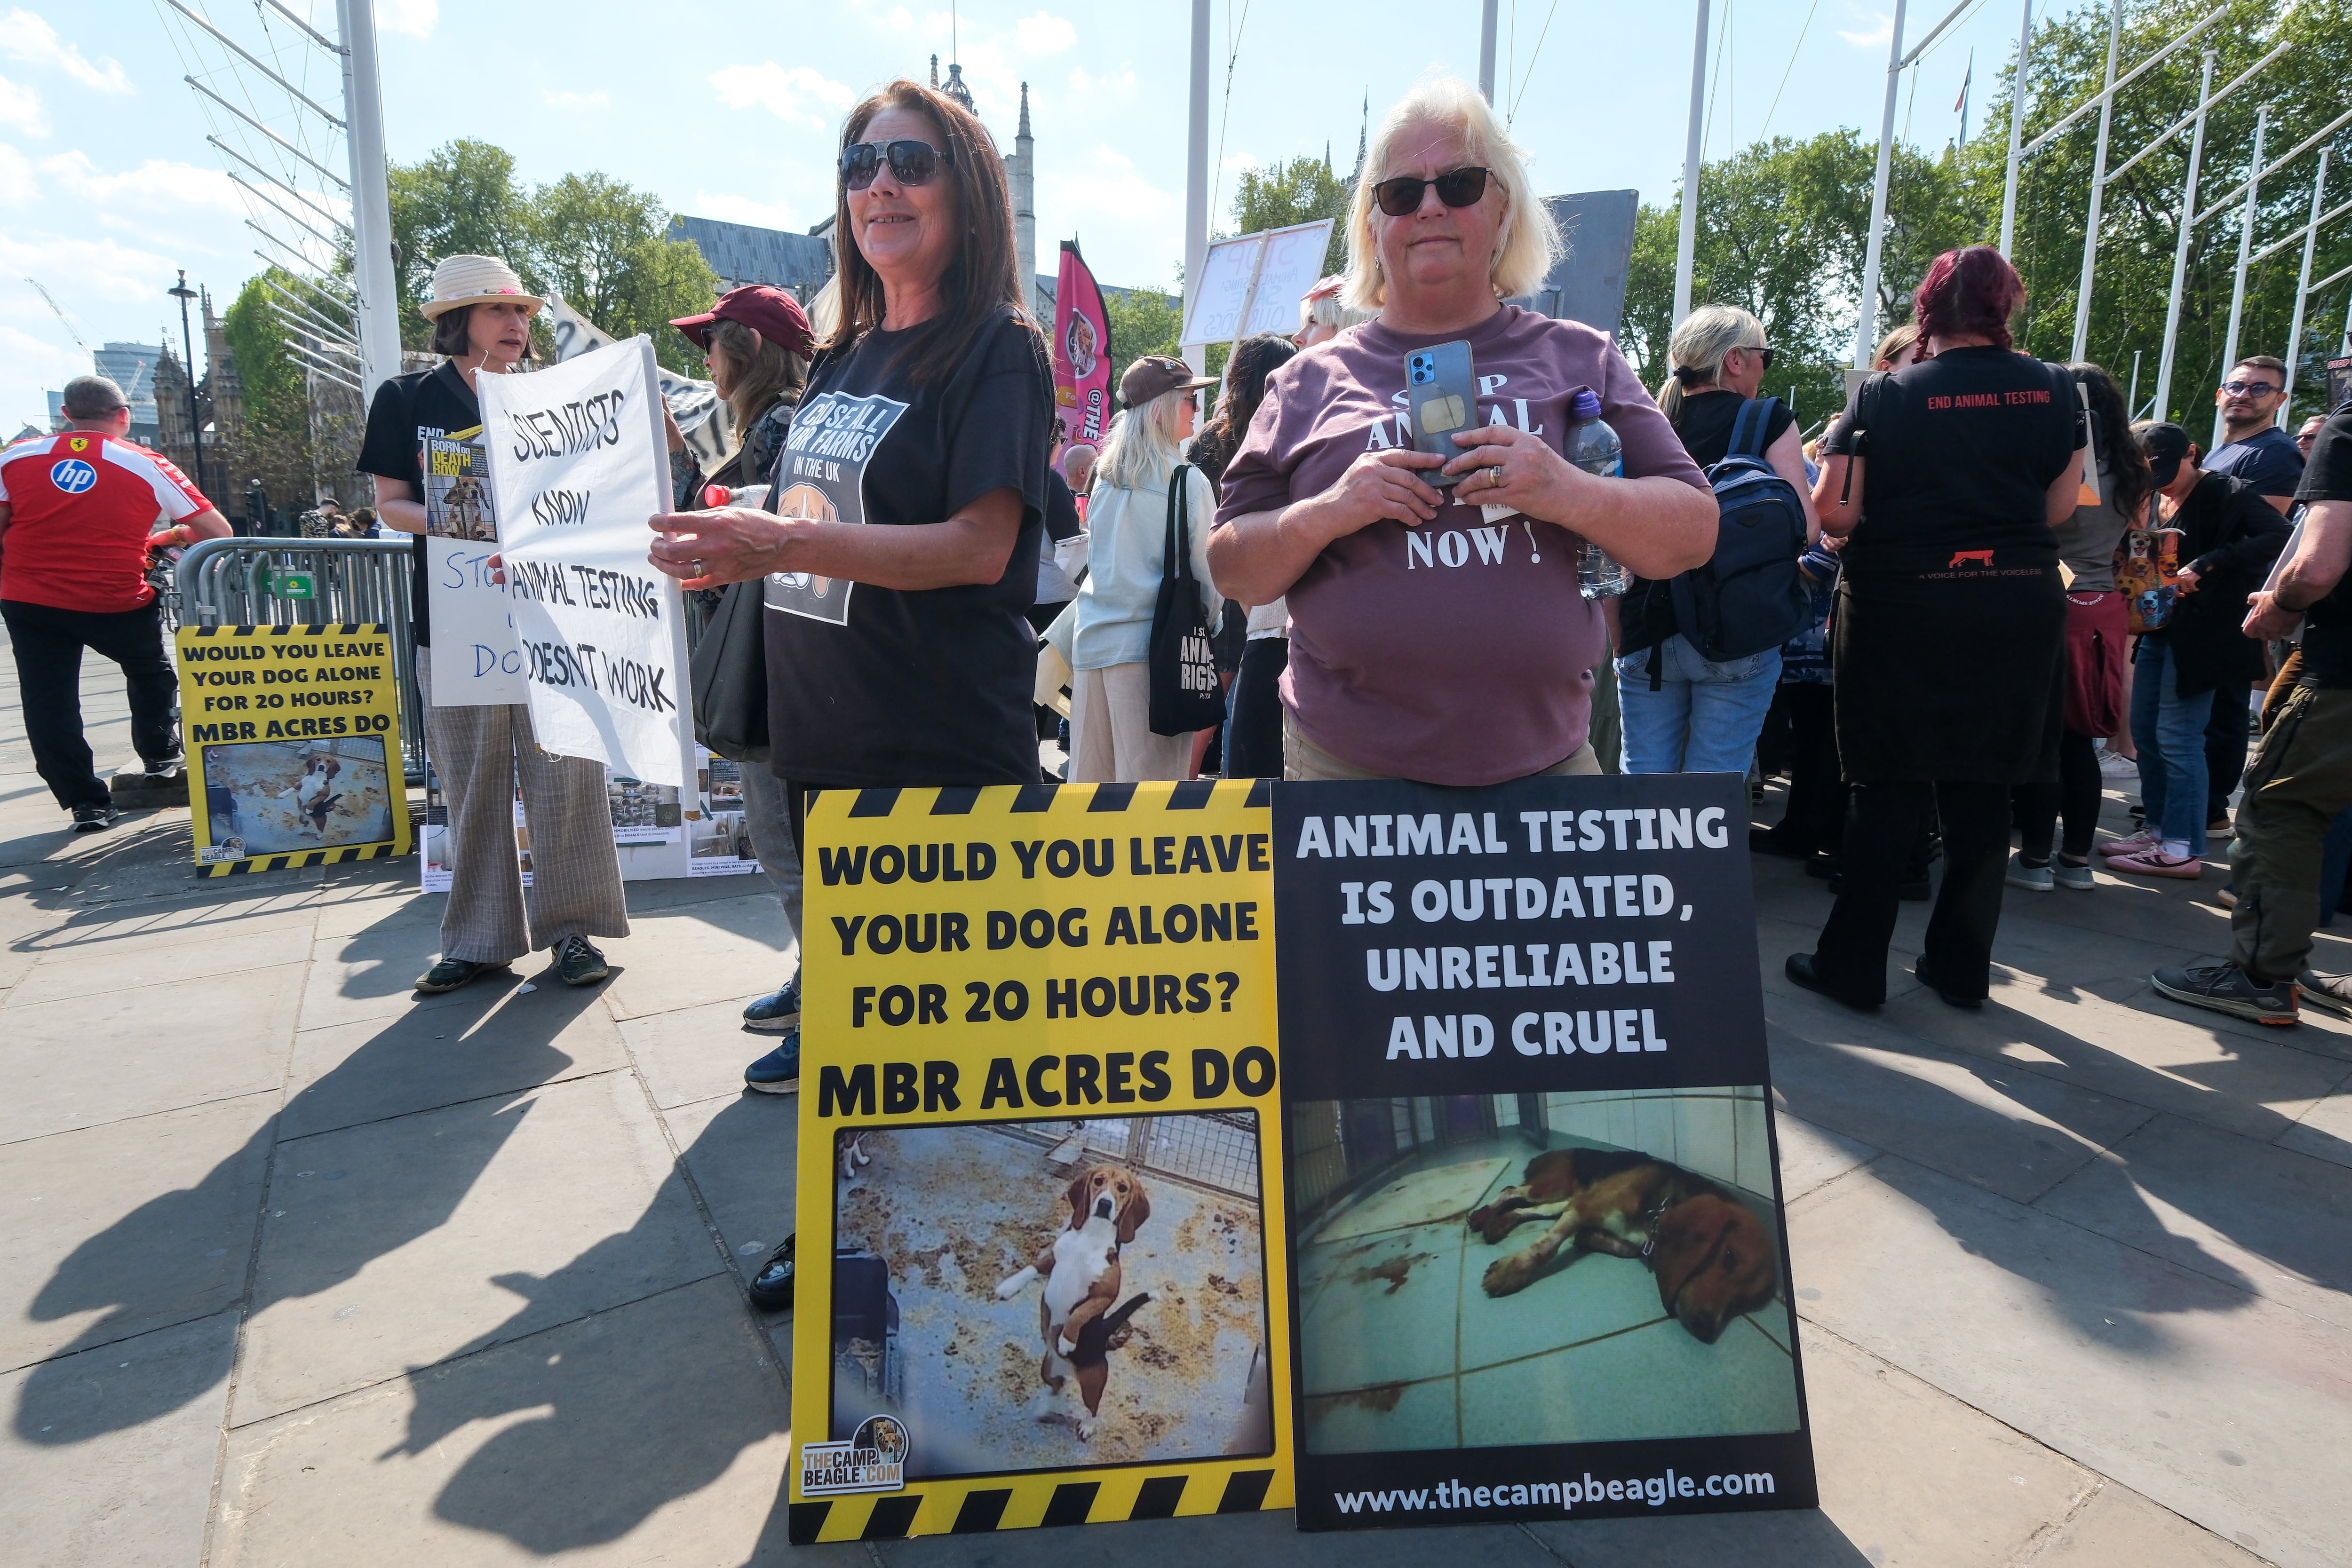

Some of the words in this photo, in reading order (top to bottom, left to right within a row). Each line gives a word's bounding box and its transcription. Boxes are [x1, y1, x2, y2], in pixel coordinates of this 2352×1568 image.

[2328, 358, 2350, 369] STOP
[1928, 396, 1951, 409] END
[1955, 393, 2001, 407] ANIMAL
[2004, 391, 2050, 404] TESTING
[504, 389, 624, 463] SCIENTISTS
[846, 404, 888, 433] ALL
[1366, 399, 1543, 451] ANAL
[431, 439, 461, 453] BORN
[432, 451, 471, 467] DEATH
[809, 429, 874, 462] FARMS
[56, 459, 92, 492] hp
[433, 463, 460, 477] ROW
[793, 456, 805, 475] IN
[805, 458, 823, 479] THE
[825, 460, 841, 483] UK
[532, 489, 590, 527] KNOW
[512, 561, 576, 606] ANIMAL
[571, 565, 659, 620] TESTING
[183, 646, 265, 662] WOULD
[271, 643, 318, 659] YOU
[325, 642, 385, 657] LEAVE
[191, 670, 255, 687] YOUR
[263, 668, 309, 684] DOG
[315, 665, 381, 682] ALONE
[602, 651, 676, 713] WORK
[204, 695, 248, 712] FOR
[255, 694, 284, 709] 20
[291, 690, 374, 708] HOURS?
[192, 721, 257, 743] MBR
[265, 716, 347, 738] ACRES
[355, 714, 390, 732] DO
[1296, 812, 1508, 858] ANIMAL
[1519, 806, 1729, 853] TESTING
[818, 842, 997, 886] WOULD
[1011, 838, 1115, 879] YOU
[1130, 833, 1270, 876] LEAVE
[1341, 881, 1395, 925] IS
[1411, 874, 1693, 923] OUTDATED,
[831, 912, 970, 956] YOUR
[986, 908, 1089, 950] DOG
[1104, 902, 1259, 946] ALONE
[1366, 940, 1676, 992] UNRELIABLE
[852, 983, 948, 1029] FOR
[964, 980, 1029, 1023] 20
[1046, 972, 1240, 1019] HOURS?
[1386, 1014, 1495, 1061] AND
[1511, 1008, 1667, 1057] CRUEL
[818, 1060, 962, 1118] MBR
[979, 1050, 1172, 1110] ACRES
[1192, 1046, 1276, 1100] DO
[804, 1449, 876, 1469] THECAMP
[1334, 1469, 1775, 1513] www.thecampbeagle.com
